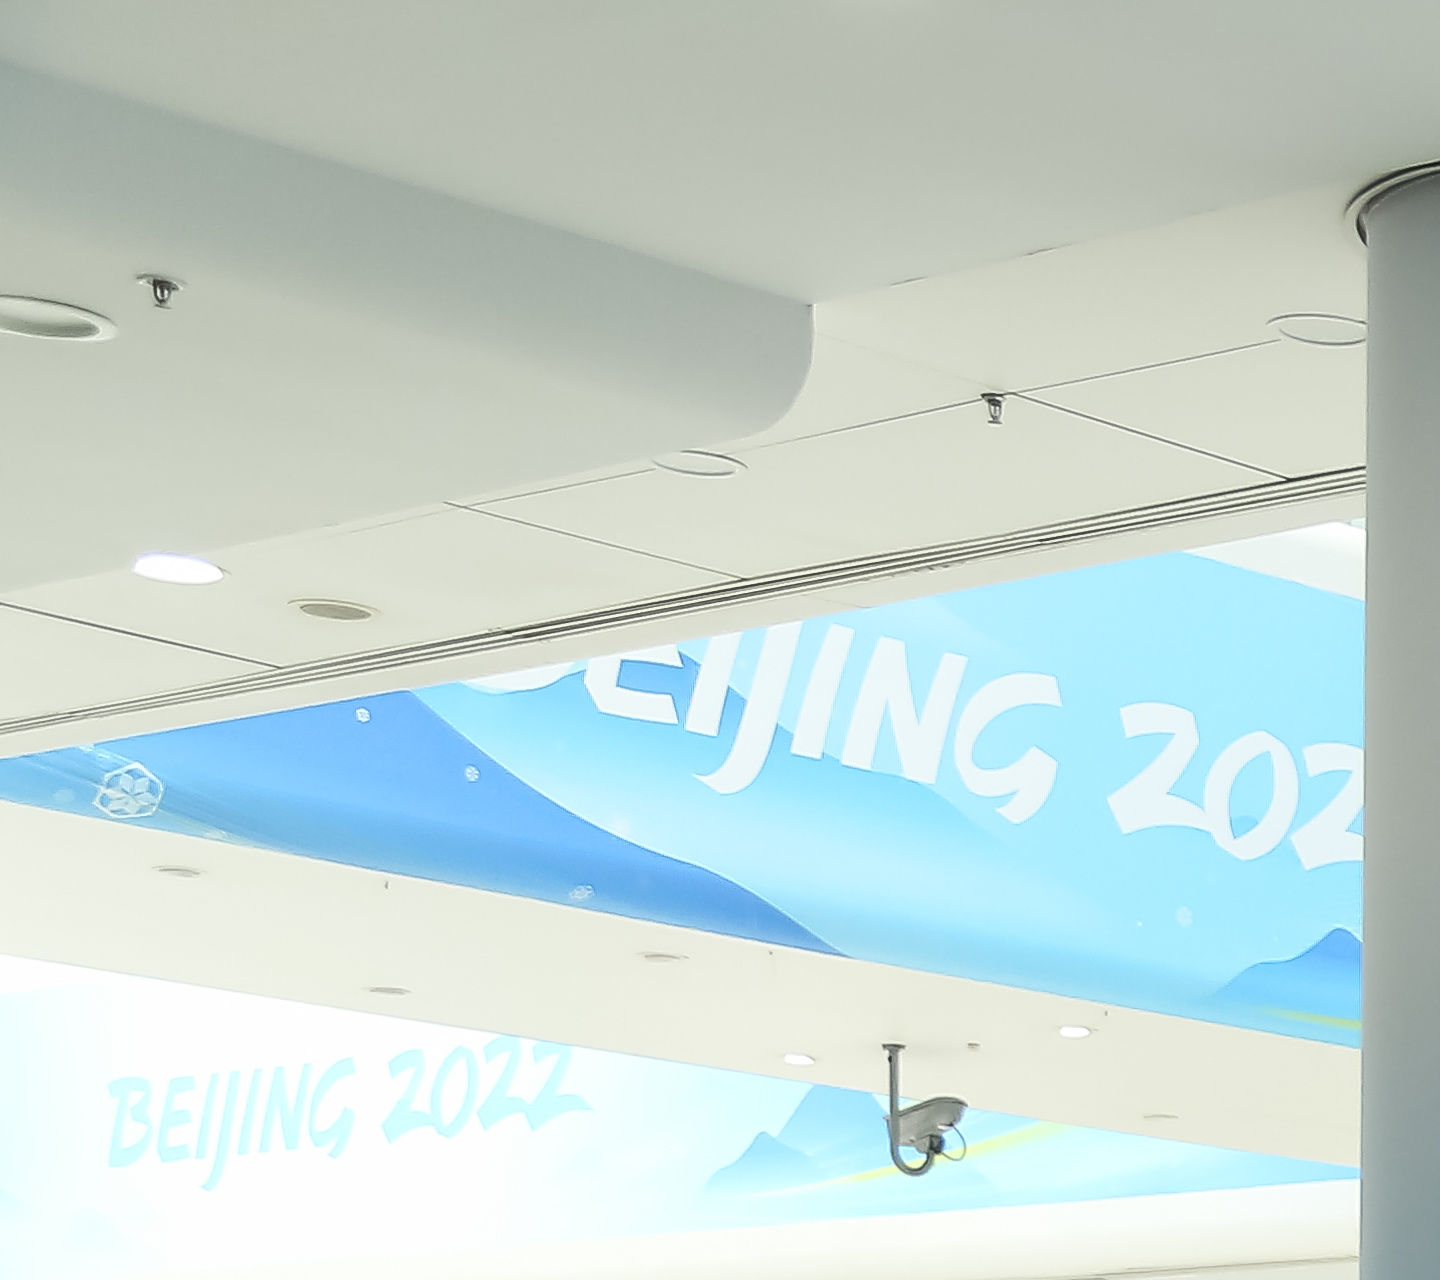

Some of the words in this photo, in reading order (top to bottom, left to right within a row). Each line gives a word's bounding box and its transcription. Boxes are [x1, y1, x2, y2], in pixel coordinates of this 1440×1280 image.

[459, 619, 1063, 825] EIJING
[107, 1056, 357, 1192] BEIJING
[381, 1034, 596, 1144] 2022
